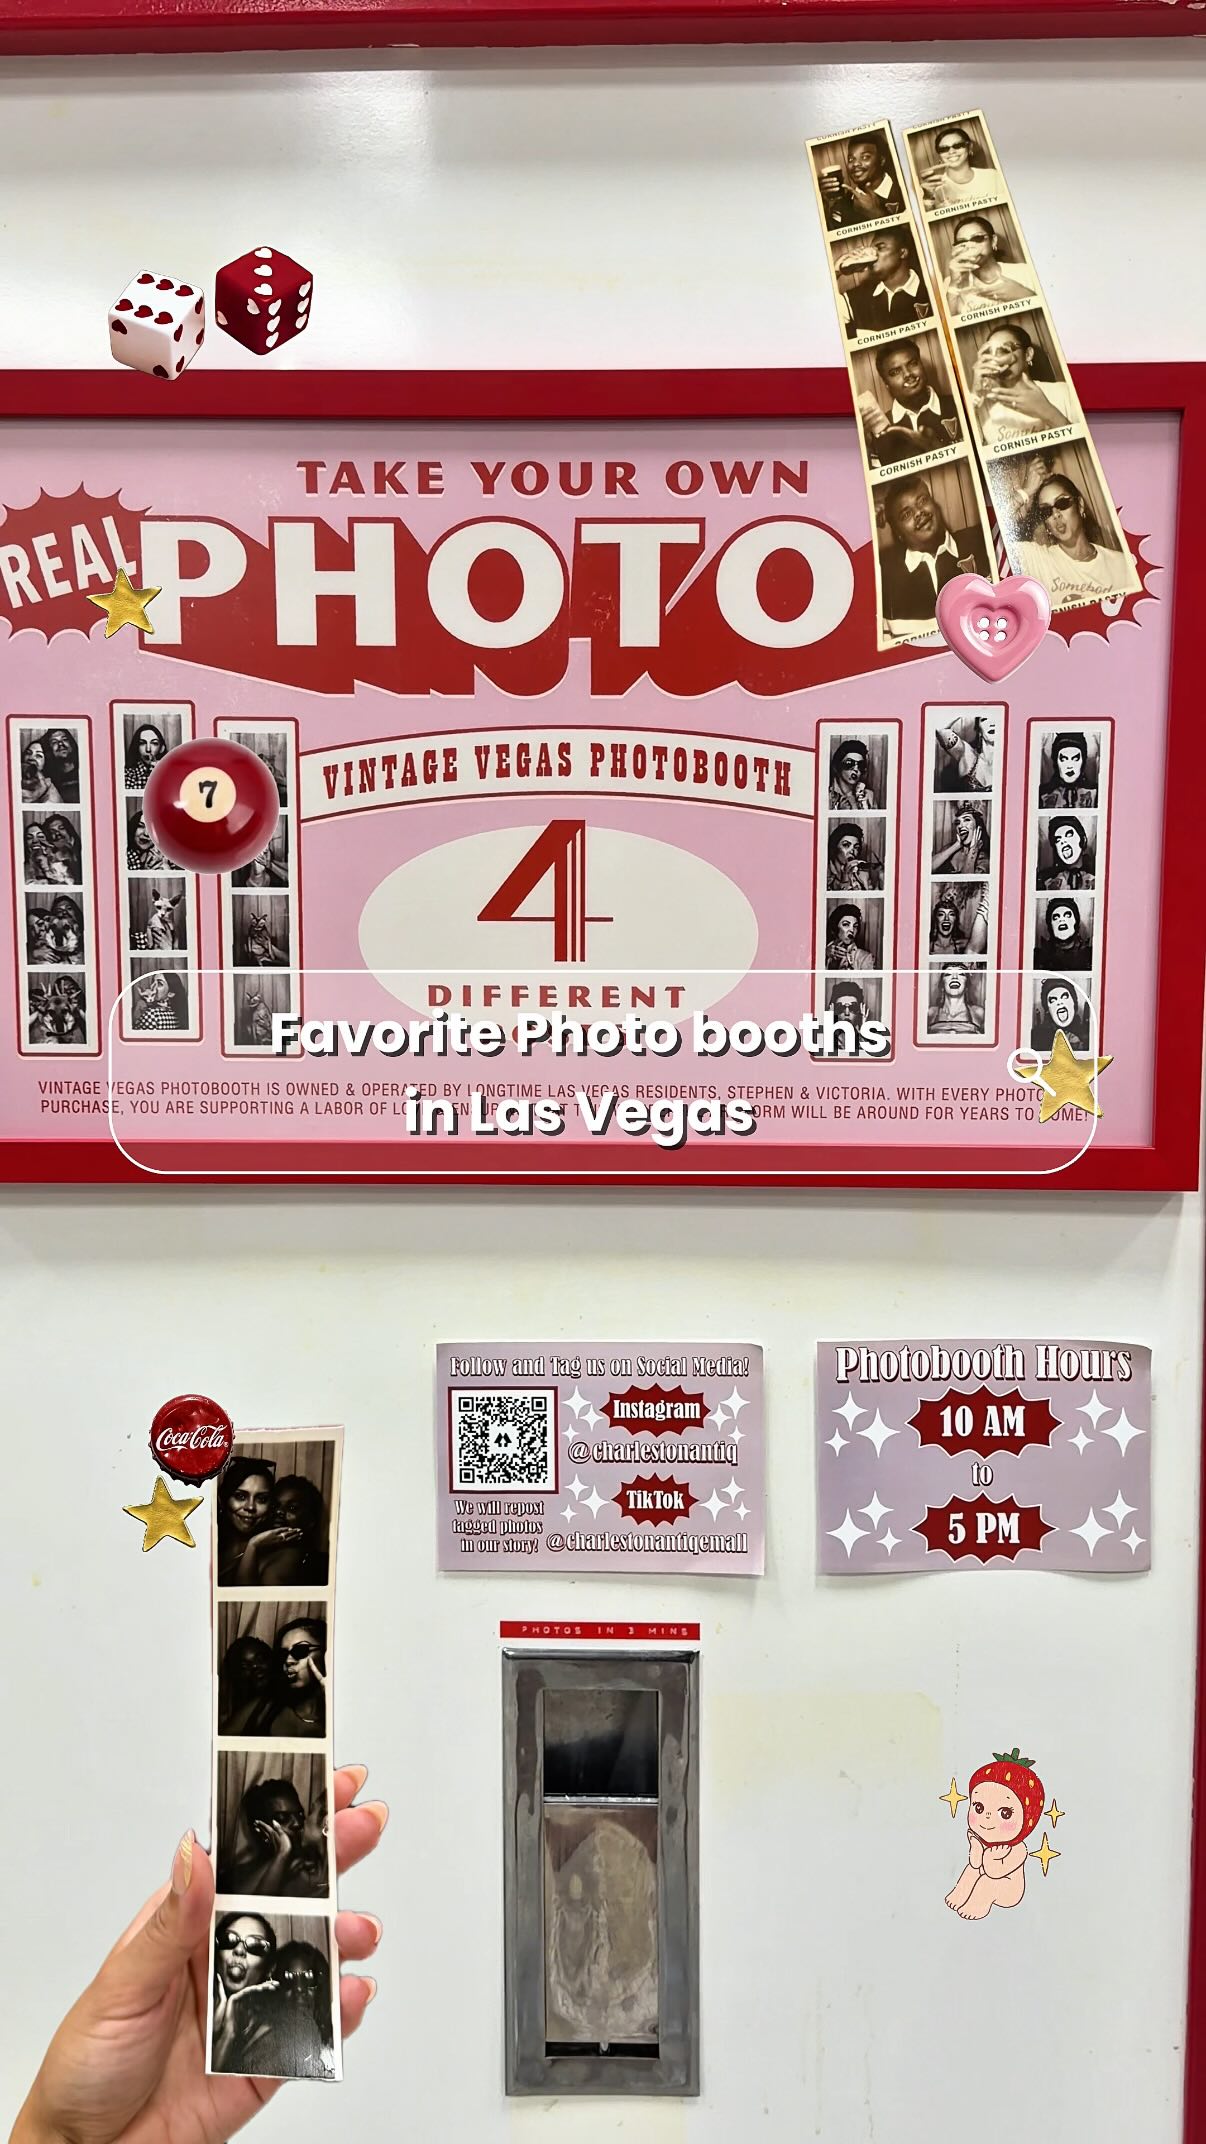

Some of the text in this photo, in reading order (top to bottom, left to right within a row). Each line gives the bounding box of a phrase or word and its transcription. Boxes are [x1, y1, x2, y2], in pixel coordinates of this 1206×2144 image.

[934, 203, 970, 217] CORNISH
[972, 196, 998, 207] PASTY
[836, 216, 901, 236] CORNISH PASTY
[960, 307, 1000, 322] CORNISH
[1002, 299, 1031, 311] PASTY
[857, 320, 927, 345] CORNISH PASTY
[994, 436, 1038, 453] CORNISH
[1040, 426, 1073, 441] PASTY
[880, 446, 957, 477] CORNISH PASTY
[297, 460, 808, 496] TAKE YOUR OWN
[0, 515, 137, 609] REAL
[140, 520, 855, 649] PHOTO
[323, 742, 792, 799] VINTAGE VEGAS PHOTOBOOTH
[199, 780, 218, 809] 7
[477, 820, 613, 962] 4
[428, 984, 686, 1008] DIFFERENT
[38, 1081, 101, 1095] VINTAGE
[106, 1081, 155, 1095] VEGAS
[161, 1082, 260, 1096] PHOTOBOOTH
[267, 1082, 280, 1096] IS
[286, 1082, 339, 1096] OWNED
[346, 1083, 356, 1097] &
[443, 1083, 462, 1097] BY
[468, 1084, 542, 1097] LONGTIME
[548, 1084, 576, 1098] LAS
[636, 1085, 721, 1100] RESIDENTS,
[727, 1086, 794, 1100] STEPHEN
[800, 1086, 810, 1100] &
[817, 1086, 891, 1101] VICTORIA.
[897, 1087, 935, 1101] WITH
[942, 1088, 990, 1101] EVERY
[41, 1100, 124, 1116] PURCHASE,
[130, 1100, 160, 1114] YOU
[165, 1101, 194, 1114] ARE
[200, 1101, 294, 1115] SUPPORTING
[300, 1101, 310, 1115] A
[315, 1102, 364, 1115] LABOR
[370, 1102, 387, 1115] OF
[751, 1104, 786, 1118] ORM
[791, 1105, 828, 1119] WILL
[834, 1106, 851, 1119] BE
[857, 1106, 918, 1119] AROUND
[925, 1106, 954, 1120] FOR
[959, 1107, 1009, 1120] YEARS
[1015, 1107, 1034, 1121] TO
[450, 1356, 750, 1378] Follow and Tag us on Social Media!
[835, 1344, 1132, 1382] Photobooth Hours
[613, 1399, 701, 1422] Instagram
[940, 1405, 1025, 1437] 10 AM
[971, 1461, 993, 1486] to
[454, 1500, 544, 1517] We will repost
[626, 1489, 685, 1509] TikTok
[452, 1519, 543, 1535] tagged photos
[948, 1512, 1020, 1545] 5 PM
[461, 1539, 539, 1554] in our story!
[546, 1530, 748, 1556] @charlestonantiqemall
[522, 1625, 688, 1636] PHOTOS IN 3 MINS
